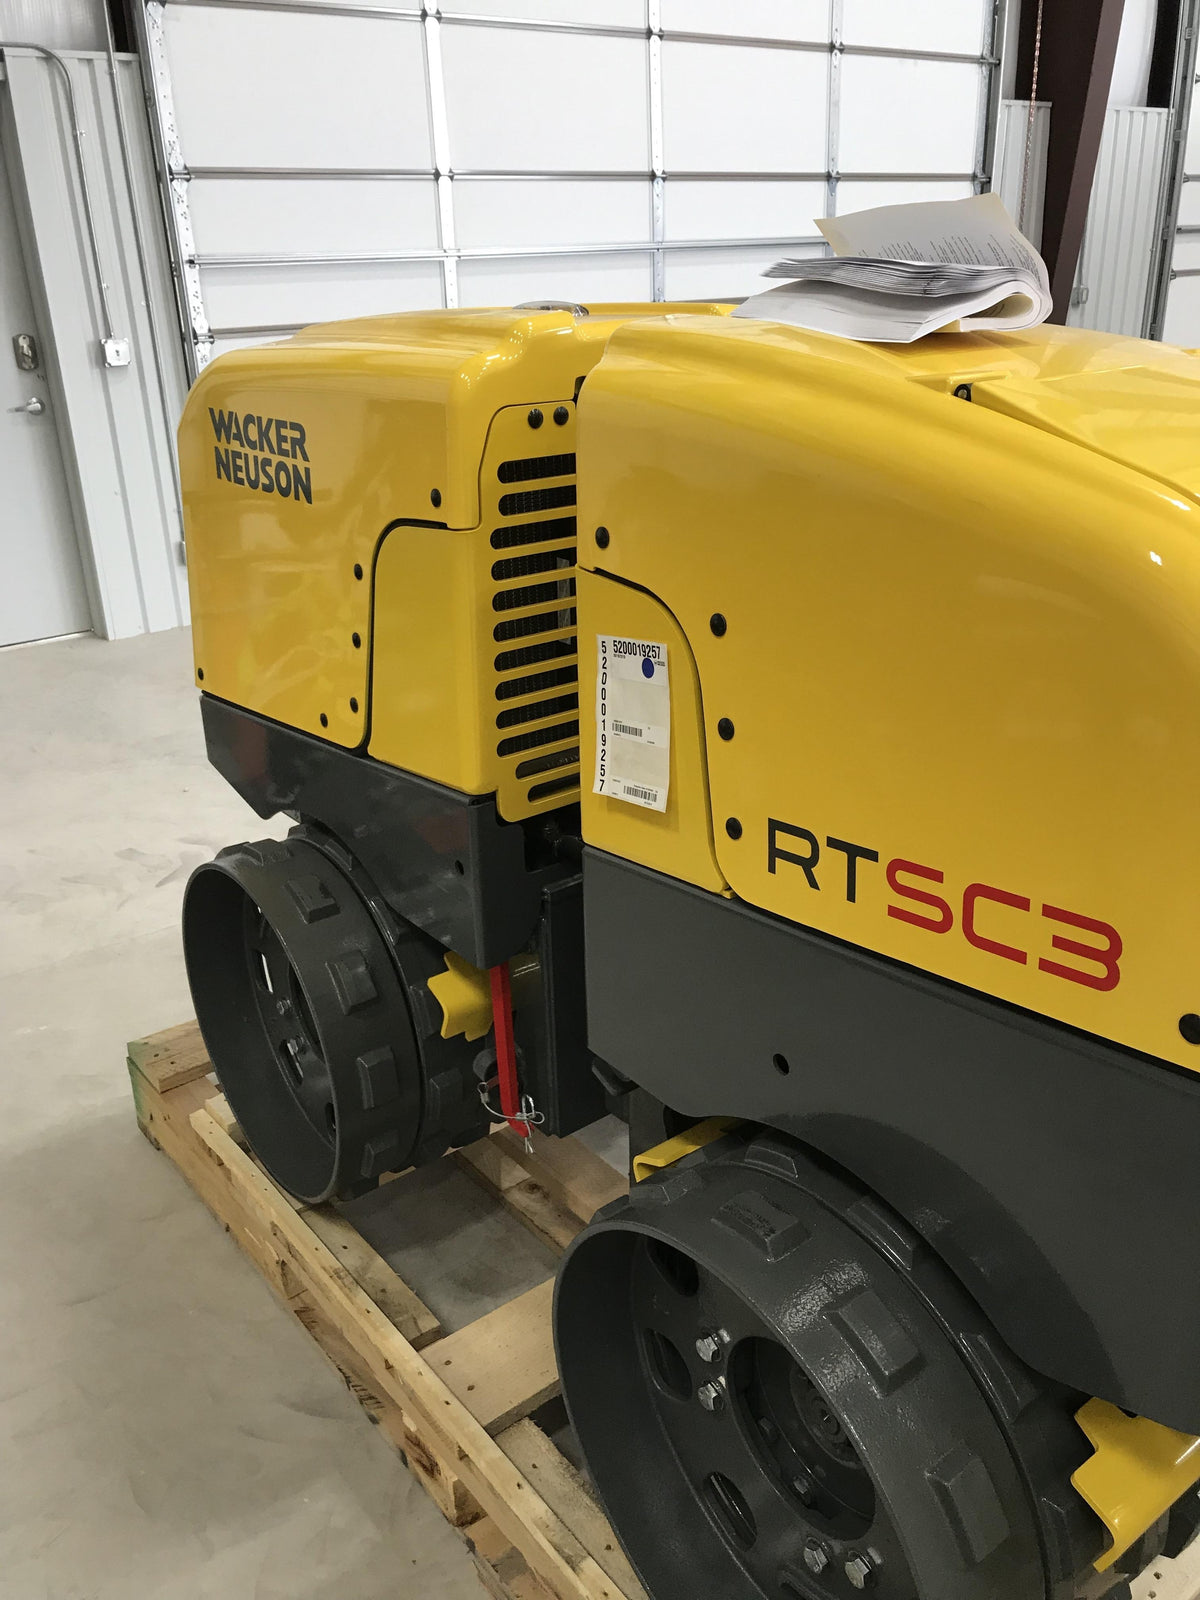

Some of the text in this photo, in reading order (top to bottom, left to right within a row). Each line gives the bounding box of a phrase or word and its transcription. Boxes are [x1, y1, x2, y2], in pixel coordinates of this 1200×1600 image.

[208, 407, 310, 462] WACKER
[214, 446, 312, 505] NEUSON
[613, 640, 661, 660] 5200019257
[767, 817, 1123, 992] RTSC3
